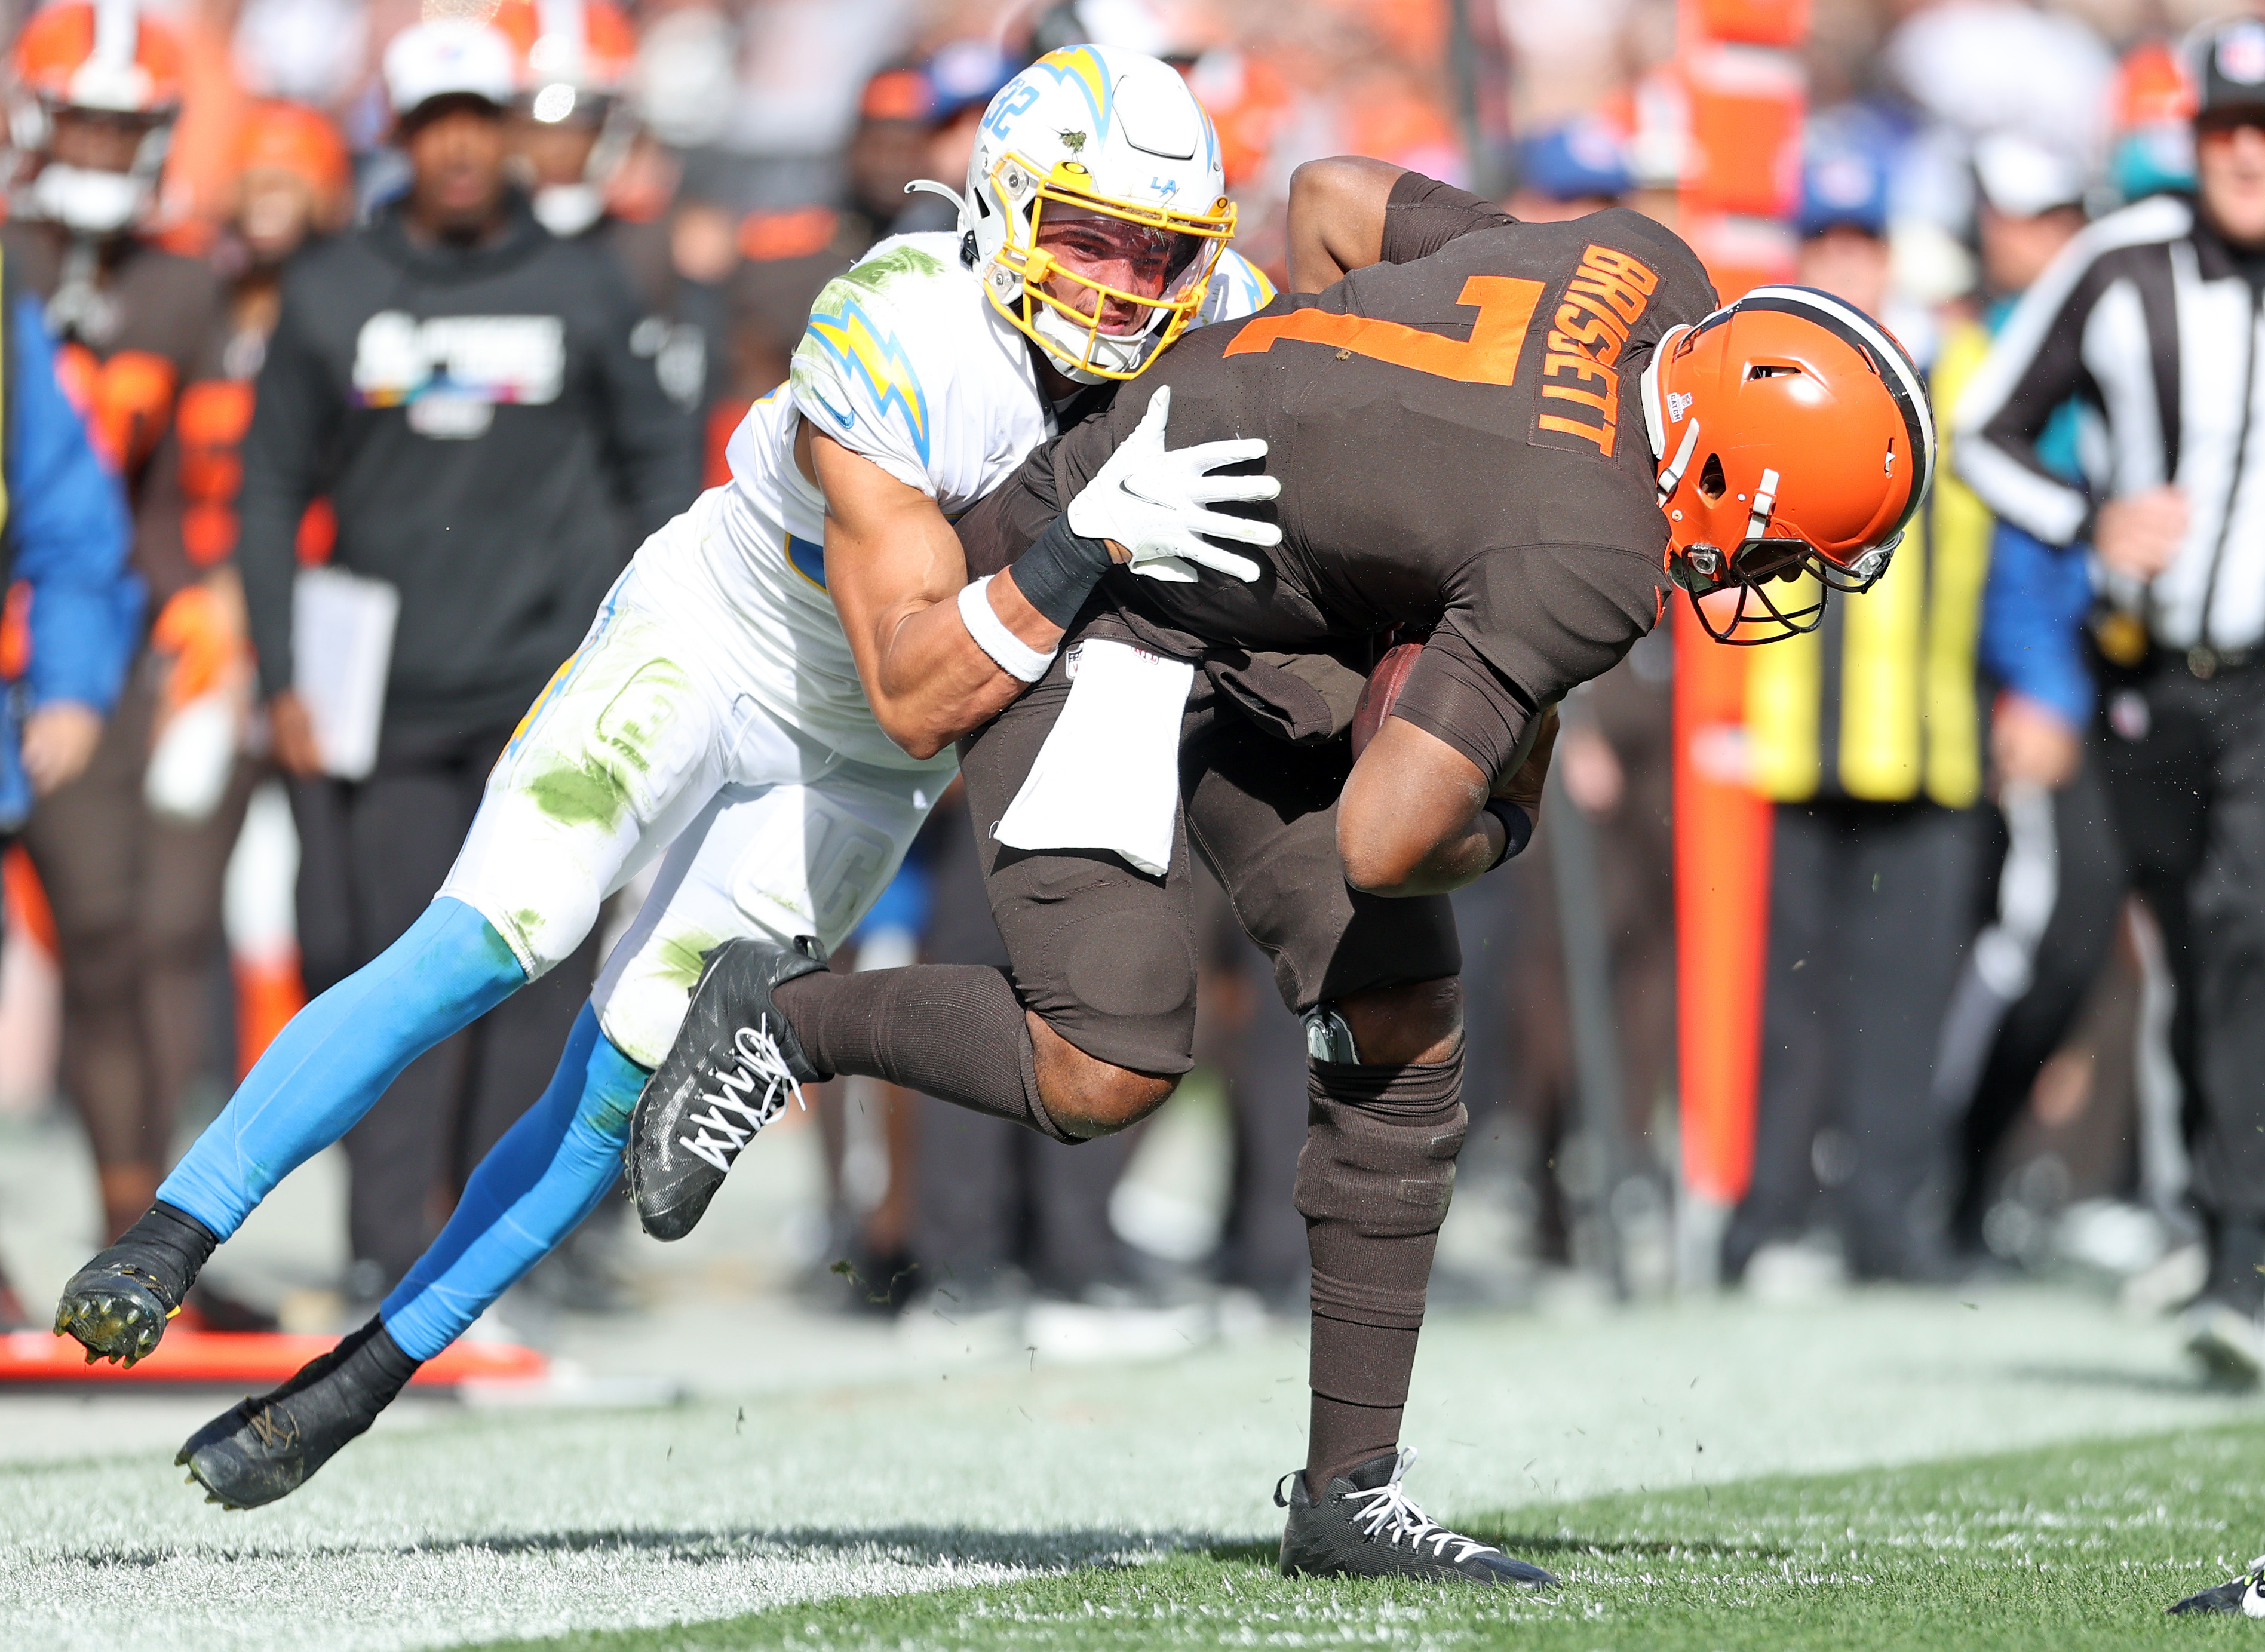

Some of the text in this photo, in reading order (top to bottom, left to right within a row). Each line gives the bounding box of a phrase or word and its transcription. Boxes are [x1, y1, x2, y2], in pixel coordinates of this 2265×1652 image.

[982, 78, 1040, 141] 32
[1150, 177, 1176, 198] LA
[1222, 275, 1546, 386] 7
[1671, 394, 1681, 420] CATCH
